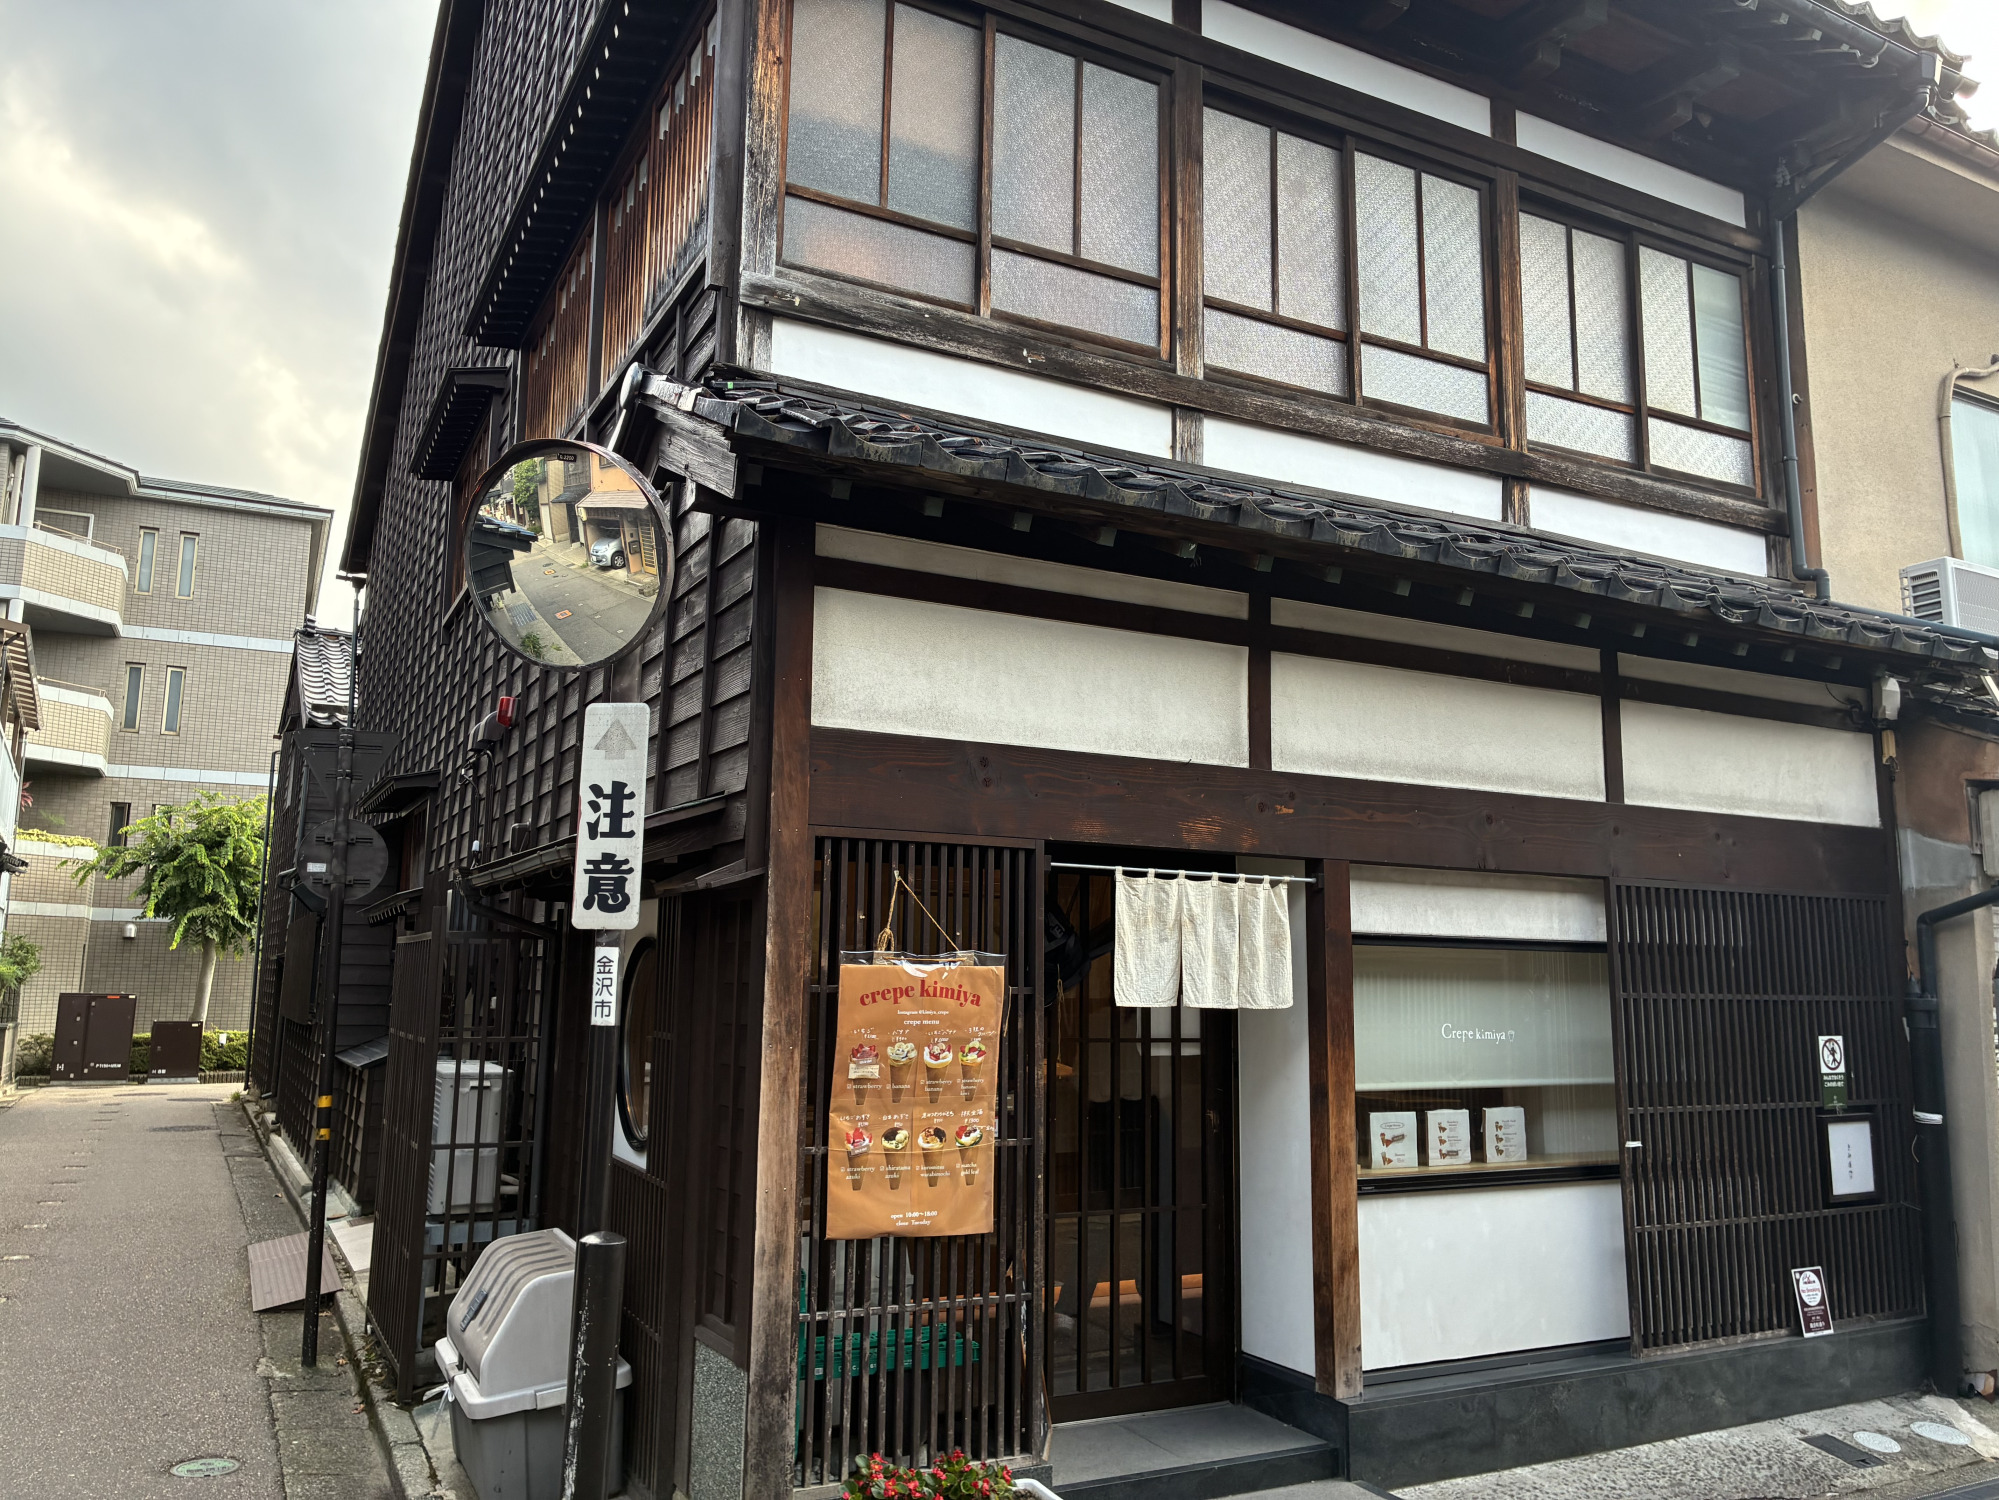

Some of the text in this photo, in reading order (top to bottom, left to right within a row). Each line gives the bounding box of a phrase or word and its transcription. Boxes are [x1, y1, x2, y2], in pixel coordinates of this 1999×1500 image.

[582, 780, 637, 914] 注意
[594, 955, 615, 1018] 金沢市
[859, 979, 981, 1008] crepe kimiya
[1441, 1023, 1506, 1045] Crepe kimiya
